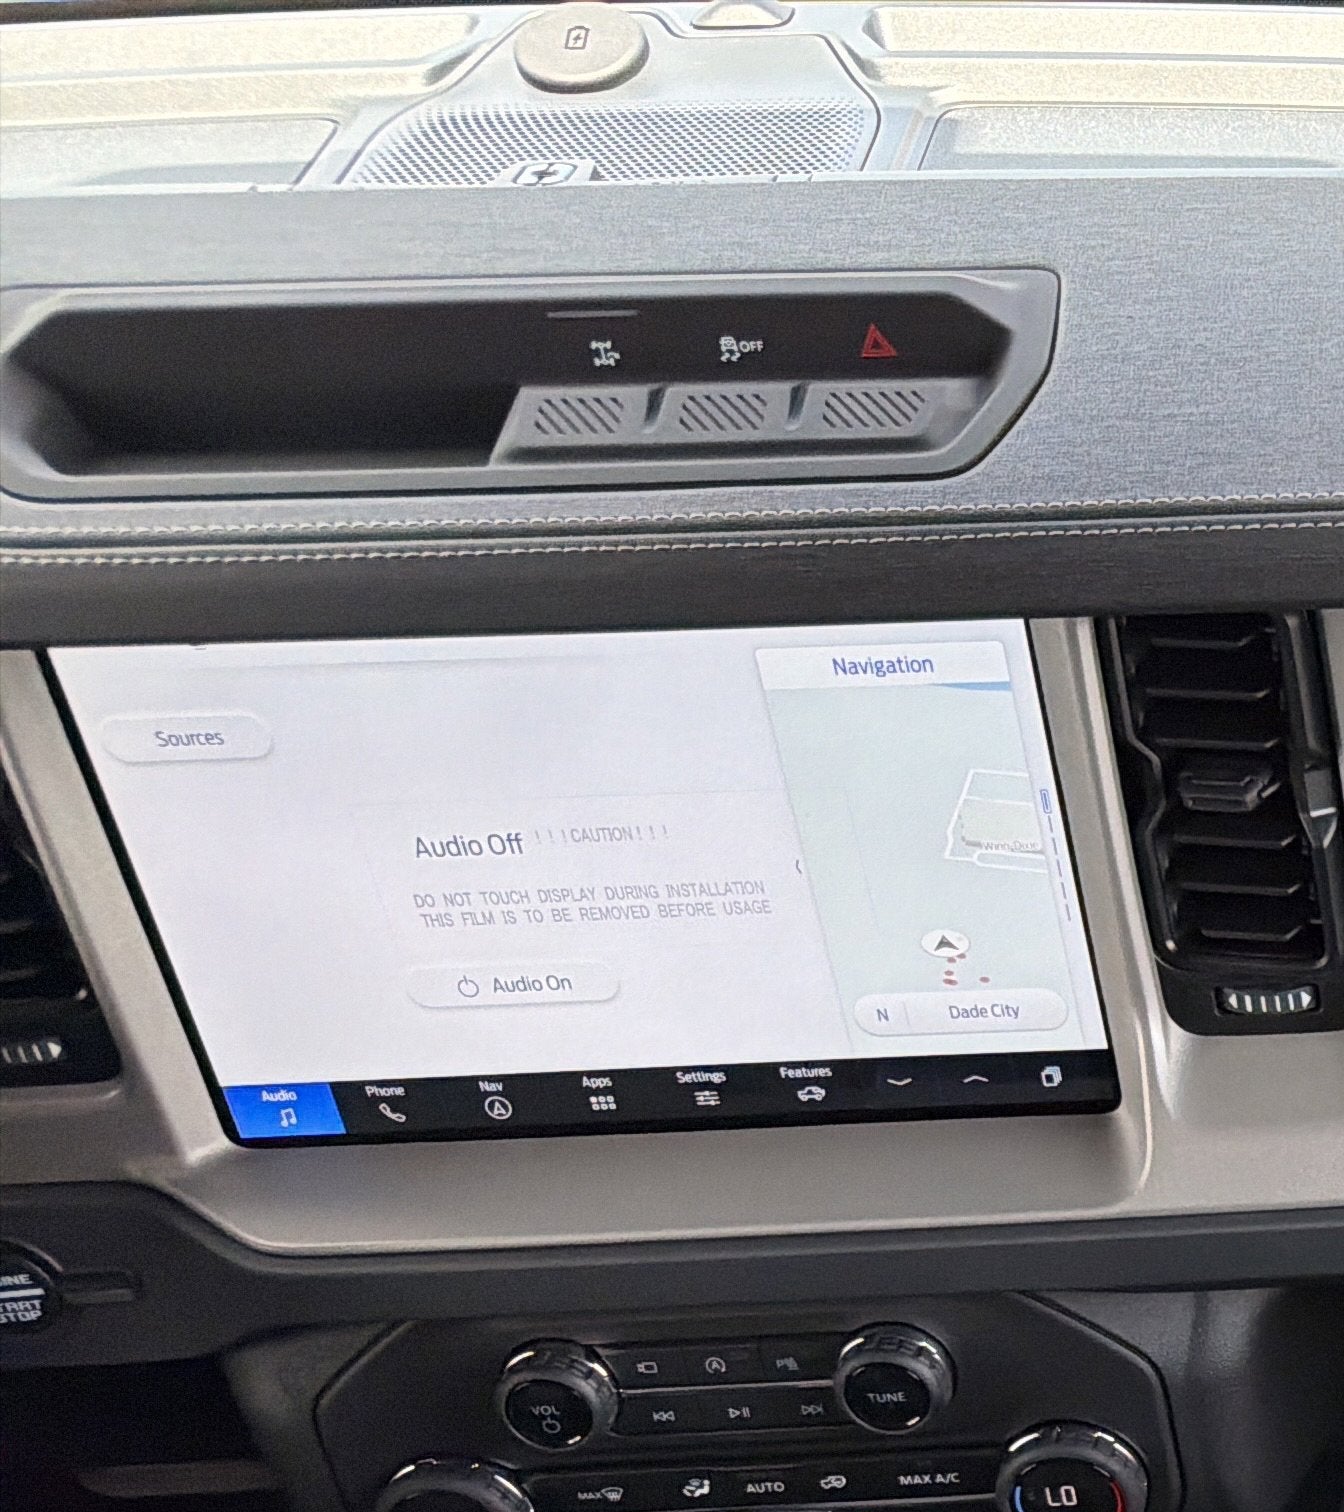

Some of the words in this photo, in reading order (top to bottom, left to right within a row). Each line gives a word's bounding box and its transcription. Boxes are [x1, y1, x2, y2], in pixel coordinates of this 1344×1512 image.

[739, 339, 764, 354] OFF
[831, 655, 935, 678] Navigation
[155, 729, 225, 748] Sources
[416, 834, 484, 859] Audio
[487, 832, 524, 856] Off
[413, 893, 437, 909] DO
[442, 891, 472, 907] NOT
[479, 889, 531, 905] TOUCH
[537, 887, 596, 904] DISPLAY
[604, 884, 660, 901] DURING
[665, 880, 766, 898] INSTALLATION
[420, 912, 455, 928] THIS
[460, 911, 496, 926] FILM
[501, 910, 518, 925] IS
[523, 909, 544, 924] TO
[551, 907, 574, 923] BE
[579, 904, 651, 922] REMOVED
[657, 902, 717, 919] BEFORE
[722, 899, 773, 916] USAGE
[492, 974, 544, 994] Audio
[547, 974, 573, 991] On
[876, 1008, 890, 1023] N
[949, 1004, 988, 1020] Dade
[991, 1003, 1020, 1020] City
[676, 1070, 727, 1084] Settings
[779, 1066, 833, 1079] Features
[478, 1080, 503, 1093] Nav
[582, 1075, 613, 1089] Apps
[261, 1089, 298, 1102] Audio
[365, 1084, 406, 1098] Phone
[867, 1391, 907, 1404] TUNE
[530, 1405, 561, 1416] VOL
[898, 1473, 931, 1486] MAX
[935, 1471, 961, 1485] A/C
[746, 1481, 785, 1495] AUTO
[577, 1491, 602, 1500] MAX
